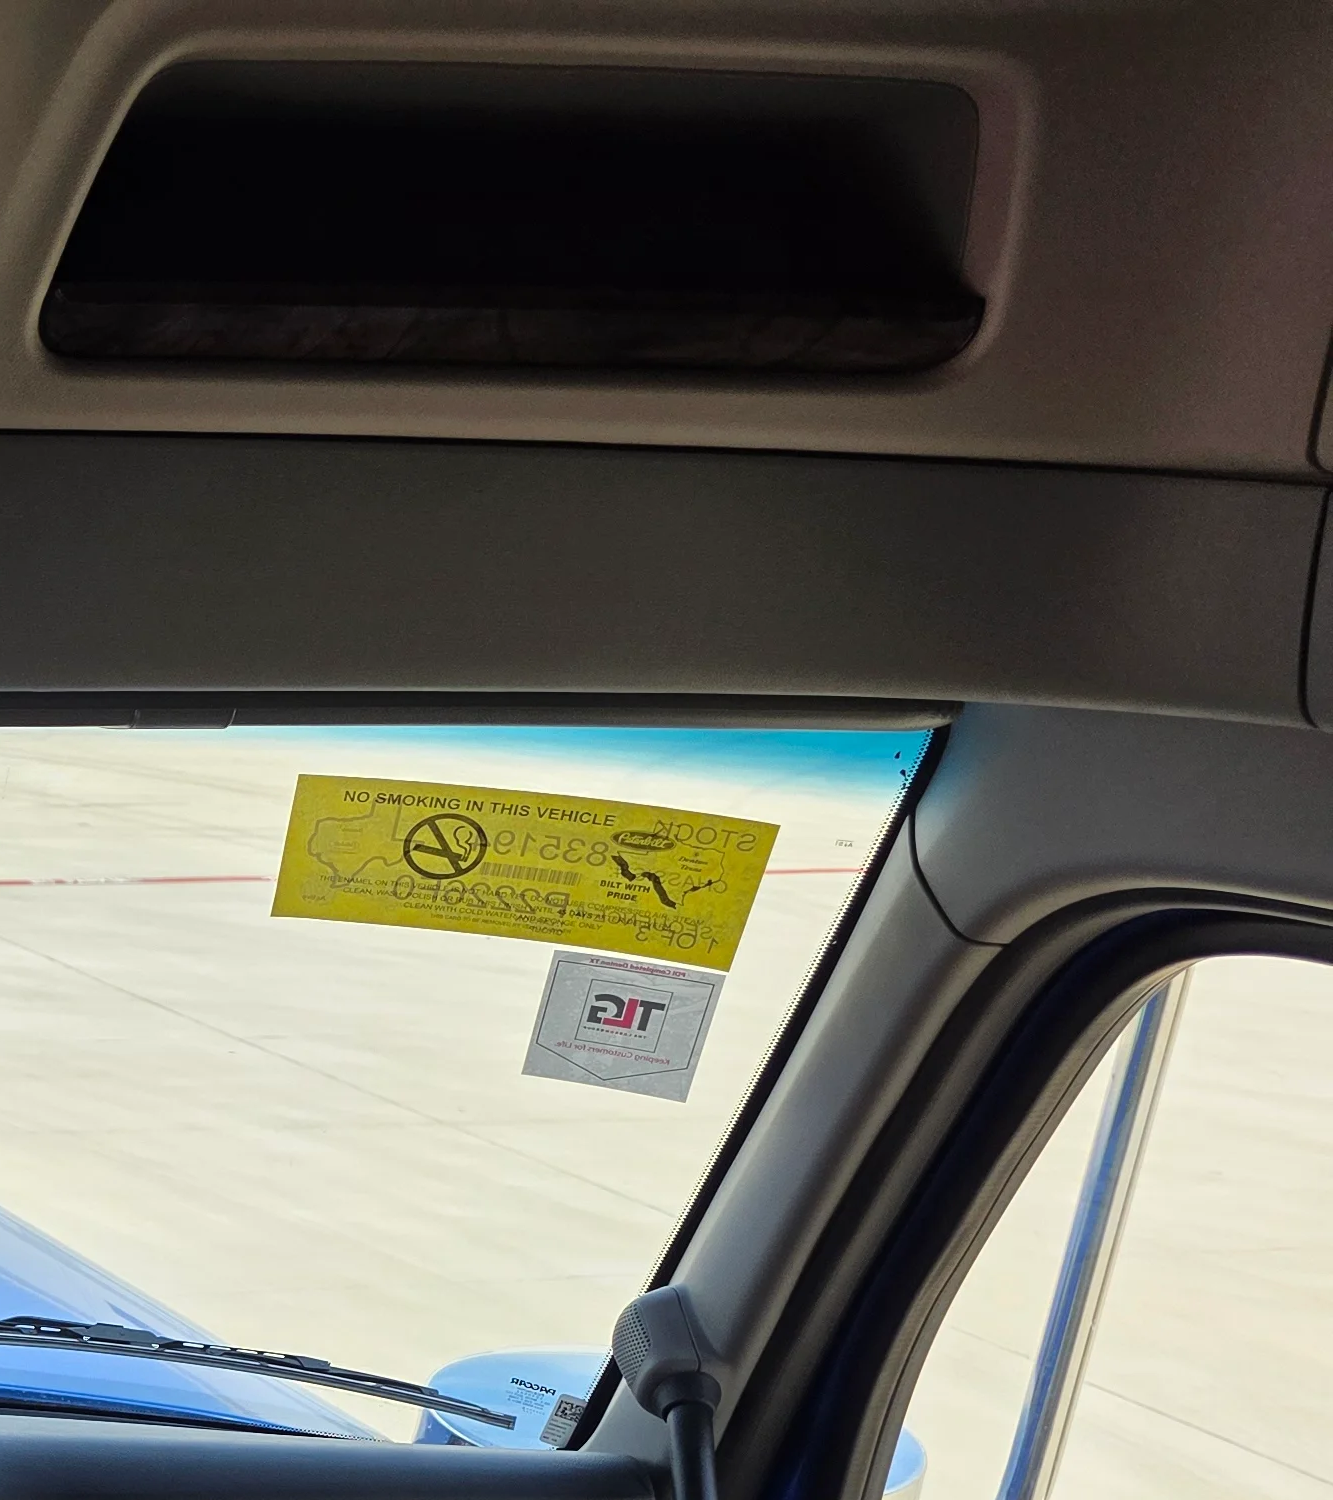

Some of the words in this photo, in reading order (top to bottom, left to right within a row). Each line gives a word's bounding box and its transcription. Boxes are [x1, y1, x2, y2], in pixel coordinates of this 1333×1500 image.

[344, 790, 370, 803] NO
[375, 792, 461, 810] SMOKING
[466, 799, 484, 812] IN
[490, 801, 531, 817] THIS
[536, 806, 617, 827] VEHICLE
[617, 832, 670, 849] Peterbilt
[338, 876, 373, 886] ENAMEL
[599, 879, 622, 889] BILT
[624, 882, 651, 893] WITH
[606, 891, 638, 902] PRIDE
[403, 901, 433, 910] CLEAN
[434, 904, 458, 913] WITH
[459, 907, 484, 916] COLD
[485, 909, 516, 919] WATER
[569, 910, 593, 919] DAYS
